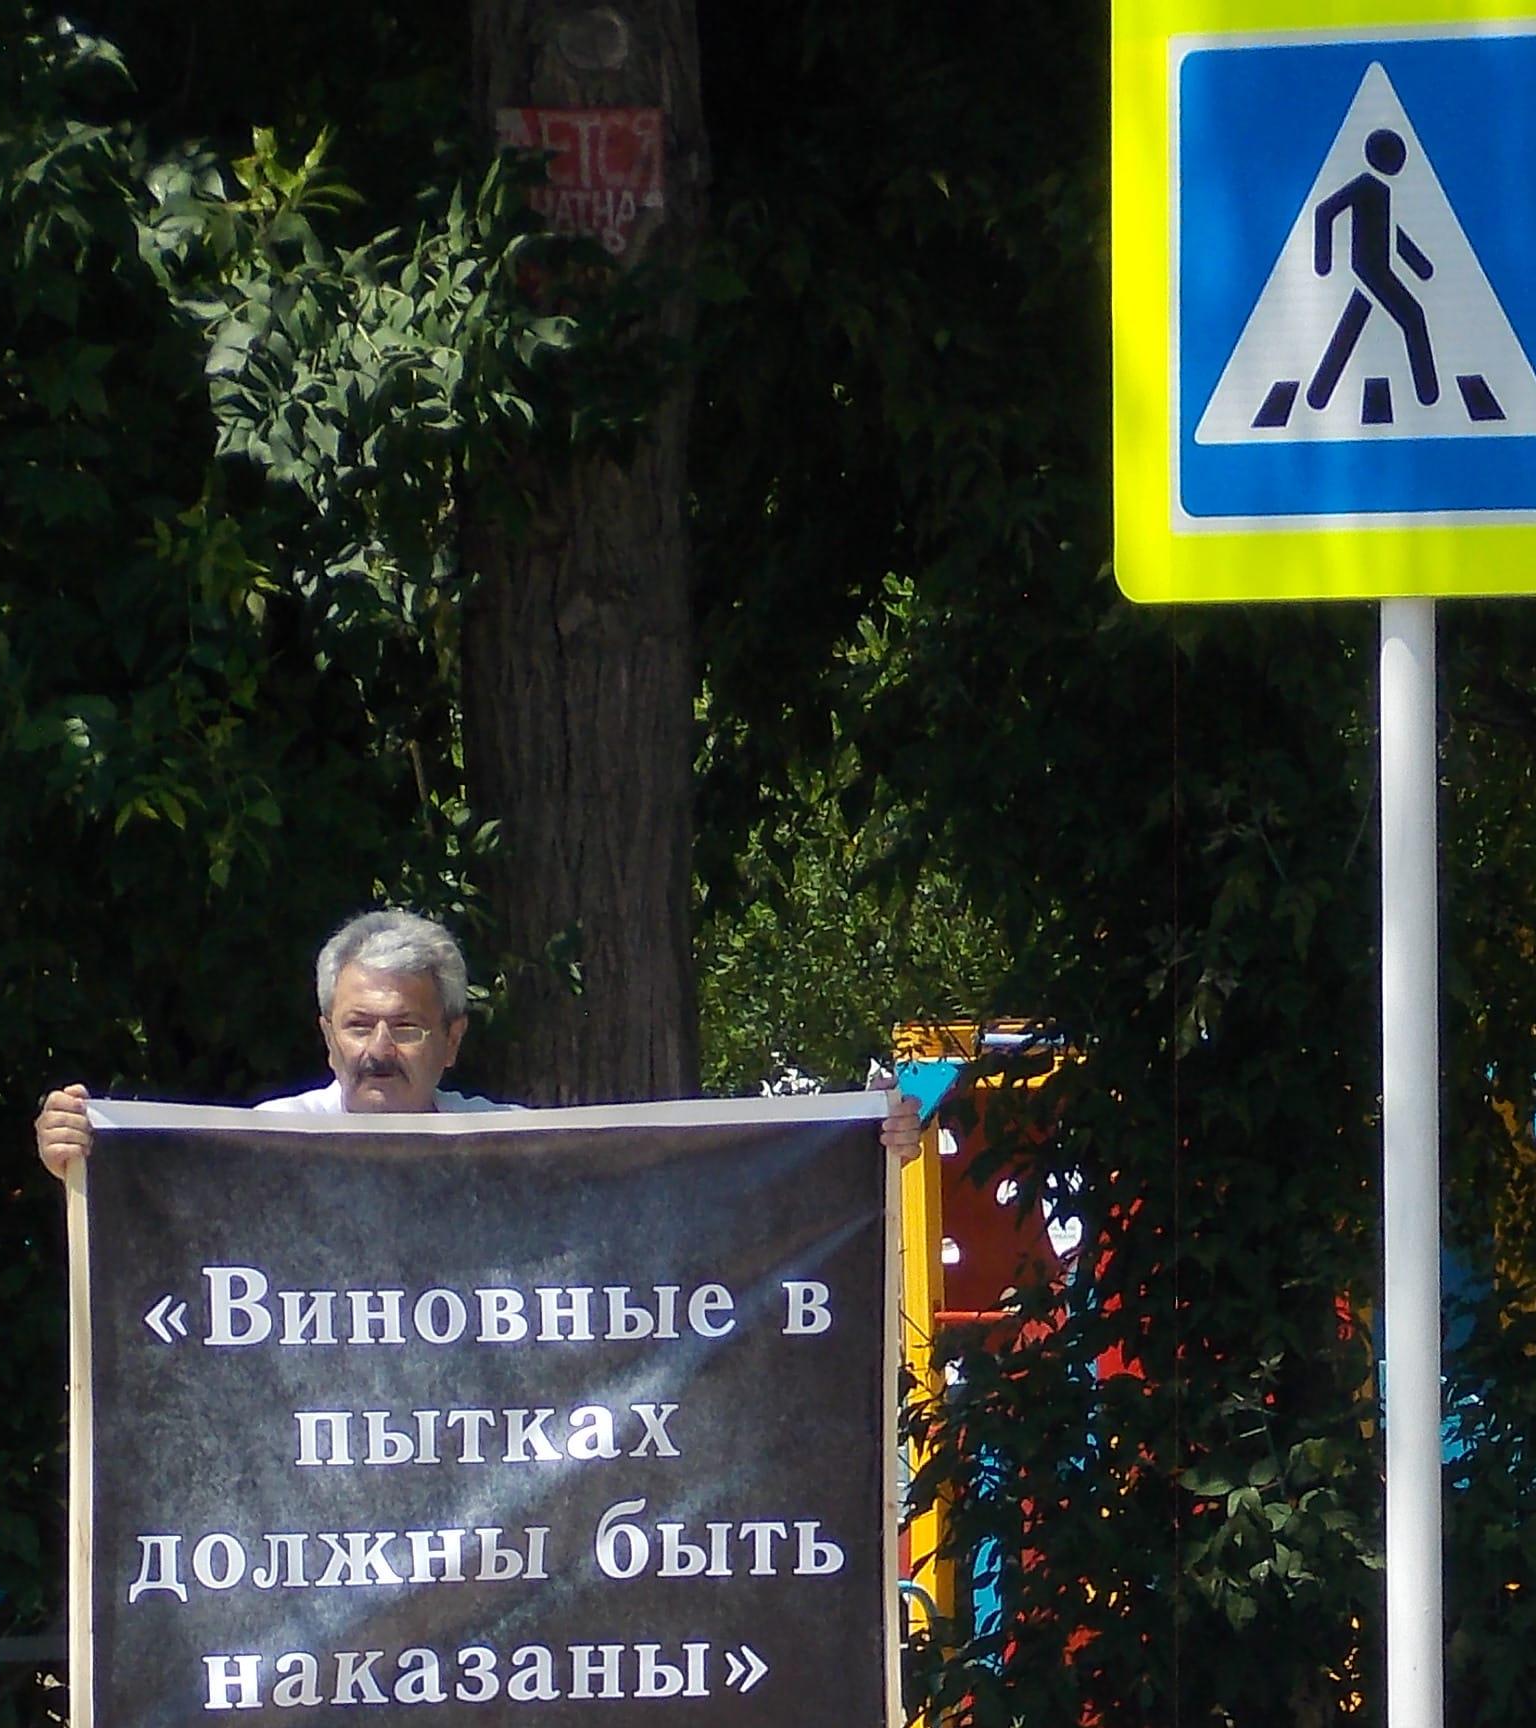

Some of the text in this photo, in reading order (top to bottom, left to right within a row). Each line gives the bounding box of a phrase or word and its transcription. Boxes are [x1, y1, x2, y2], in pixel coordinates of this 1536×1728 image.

[143, 1266, 833, 1347] «Виновные в
[292, 1402, 683, 1466] пытках
[128, 1497, 845, 1604] должны быть
[201, 1642, 769, 1711] наказаны»
